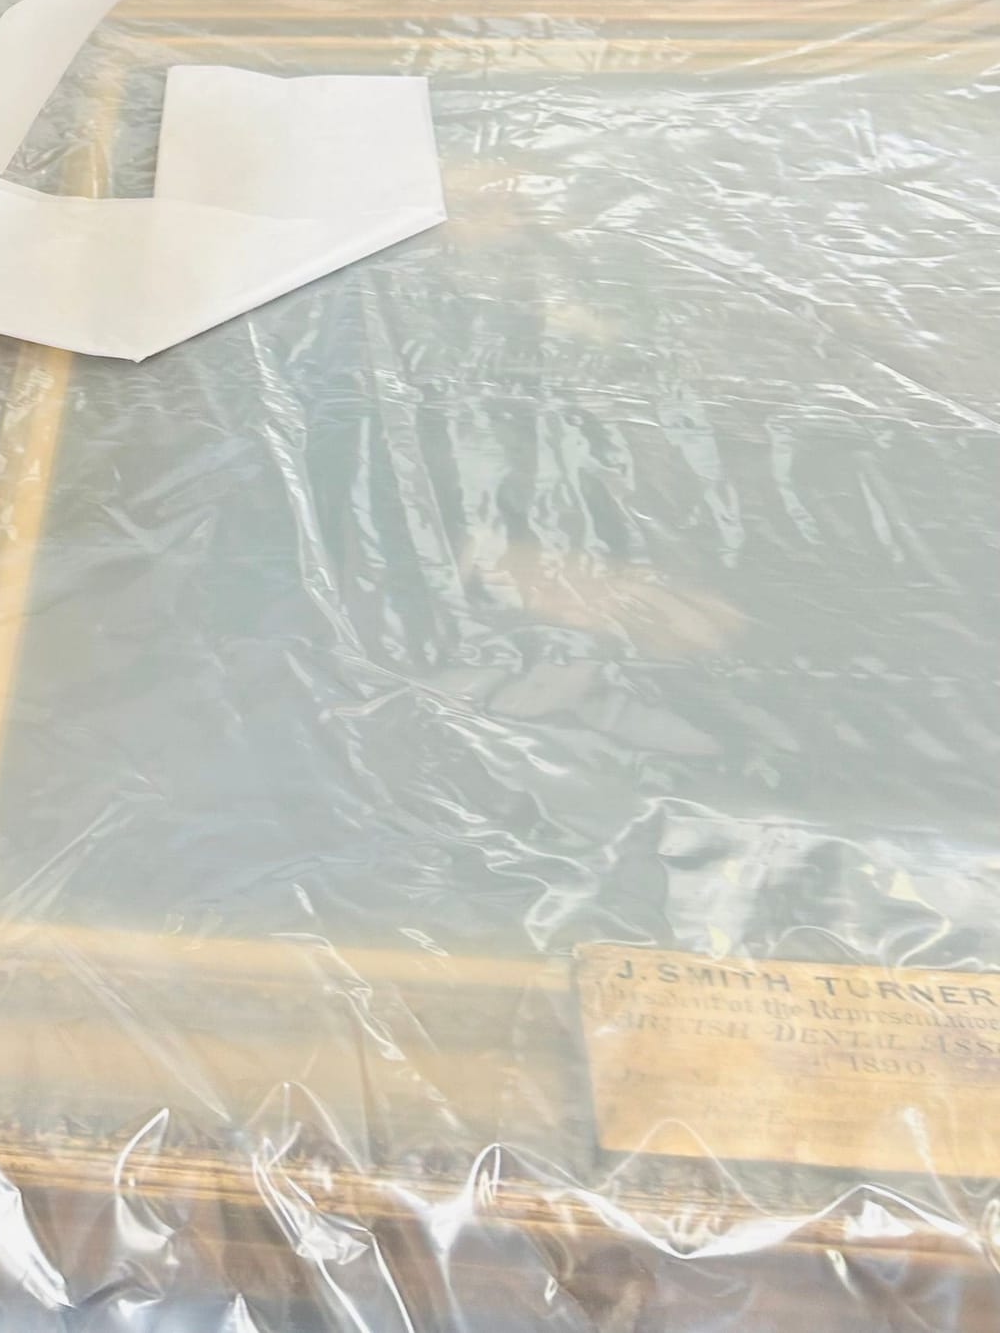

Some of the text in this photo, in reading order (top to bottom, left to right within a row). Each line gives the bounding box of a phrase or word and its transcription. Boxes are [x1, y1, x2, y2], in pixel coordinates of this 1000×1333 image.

[615, 959, 998, 1008] J. SMITH TURNER
